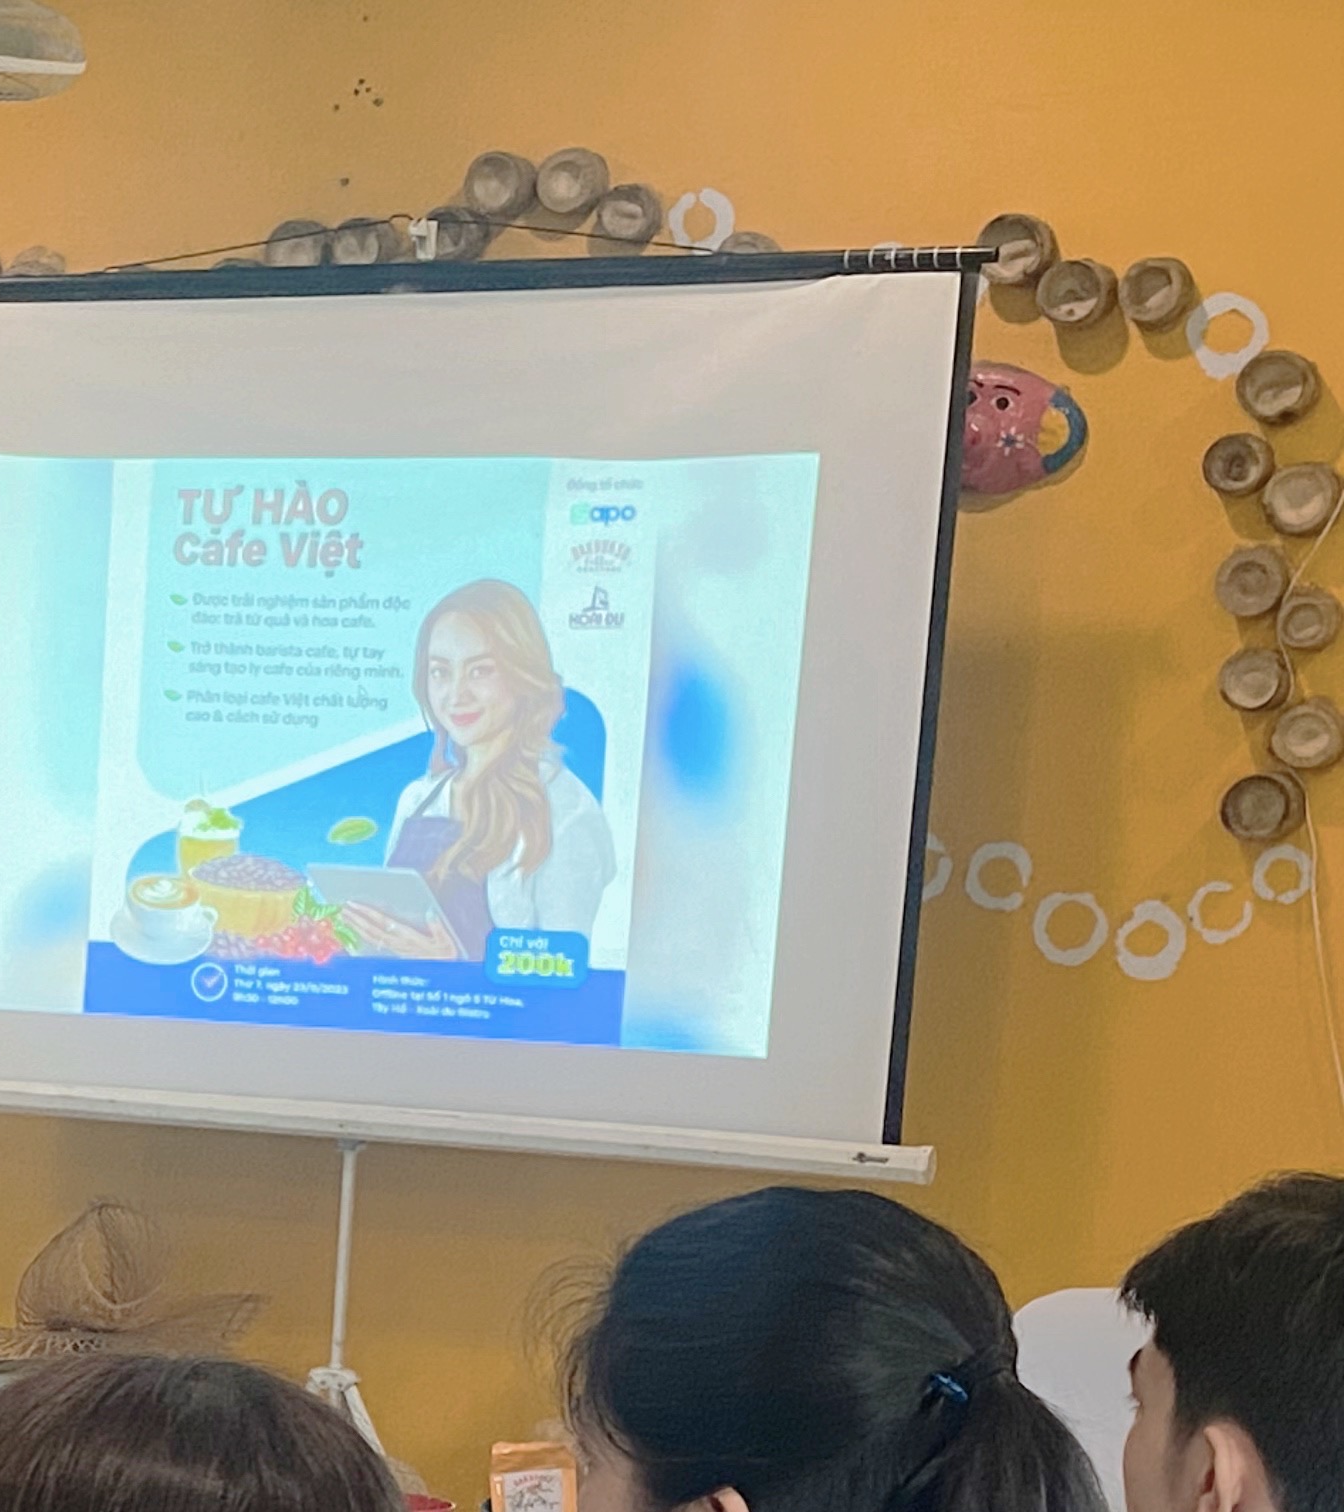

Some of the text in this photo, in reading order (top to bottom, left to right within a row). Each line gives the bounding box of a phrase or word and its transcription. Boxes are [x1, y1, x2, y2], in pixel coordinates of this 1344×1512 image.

[178, 480, 348, 534] TỰ HÀO
[174, 529, 364, 578] Cafe Việt
[192, 592, 410, 612] Được trải nghiệm sản phẩm độc
[312, 614, 338, 627] hoa
[214, 641, 253, 655] thành
[256, 643, 302, 657] barista
[363, 647, 384, 661] tay
[263, 663, 293, 676] cafe
[296, 662, 321, 677] của
[187, 689, 220, 703] Phân
[224, 690, 247, 705] loại
[250, 691, 279, 704] cafe
[283, 692, 310, 707] Việt
[313, 692, 343, 707] chất
[185, 711, 210, 721] cao
[226, 710, 259, 723] cách
[283, 711, 318, 727] dụng
